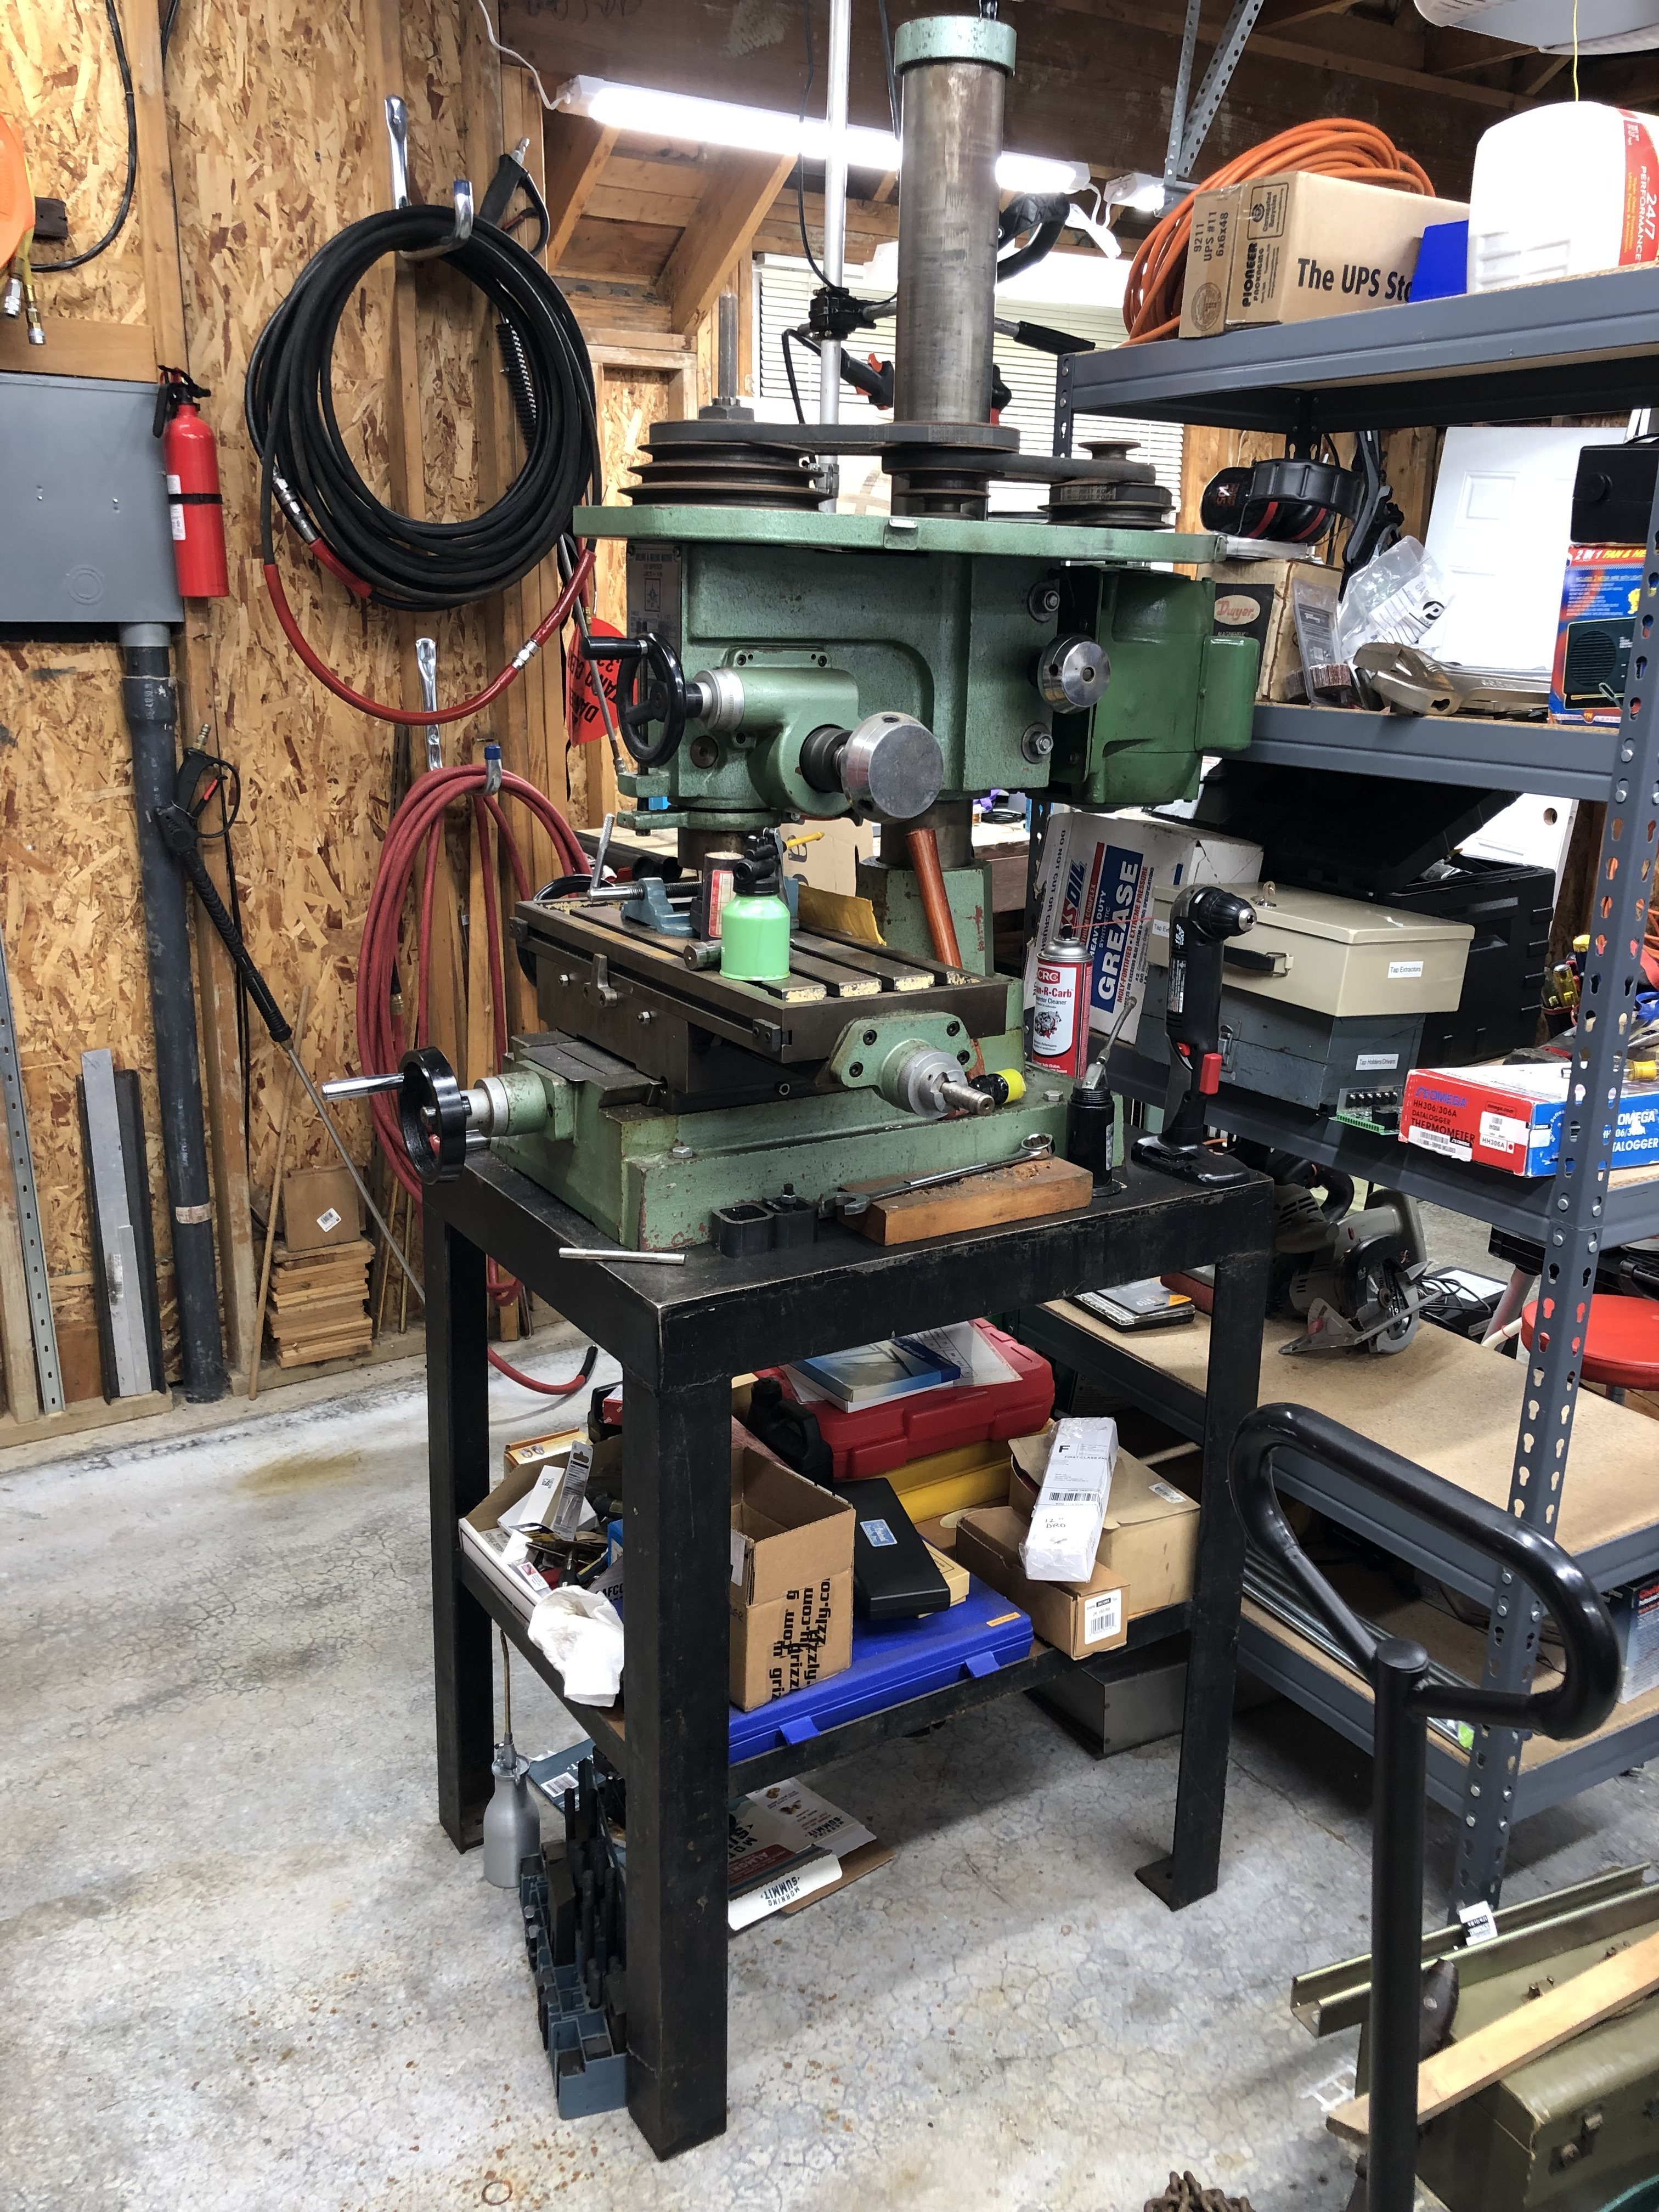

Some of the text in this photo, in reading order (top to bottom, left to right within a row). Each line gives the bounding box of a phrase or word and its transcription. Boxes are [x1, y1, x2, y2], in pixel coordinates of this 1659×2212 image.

[1635, 166, 1647, 261] PERFORMANCE
[1645, 193, 1657, 240] 24/7
[1193, 223, 1204, 253] 9211
[1204, 211, 1217, 262] UPS #11
[1216, 212, 1229, 257] 6x6x48
[1242, 242, 1257, 307] PIONEER
[1253, 248, 1264, 301] PACKAGING
[1298, 258, 1334, 291] The
[1341, 264, 1381, 297] UPS
[1574, 550, 1583, 560] 2
[1583, 549, 1595, 561] IN
[1595, 550, 1603, 559] 1
[1602, 549, 1623, 559] FAN
[1216, 600, 1255, 620] Dwyer
[1059, 830, 1066, 845] DO
[1047, 897, 1054, 912] OR
[1085, 884, 1097, 917] COMPLEX
[1096, 890, 1107, 921] DUTY
[1098, 906, 1110, 949] SYNTHETIC
[1098, 861, 1138, 1000] GREASE
[1117, 946, 1132, 1003] MOLY-FORTIFIED
[1136, 866, 1148, 903] PRESSURE
[1037, 969, 1059, 983] CRC
[1413, 1099, 1457, 1118] HH306/306A
[1432, 1090, 1468, 1108] OMEGA
[1411, 1118, 1475, 1143] THERMOMETER
[1412, 1109, 1451, 1125] DATALOGGER
[1617, 1110, 1655, 1126] OMEGA
[1482, 1136, 1505, 1148] HH306A
[764, 1876, 798, 1900] SUMMIT
[768, 1886, 800, 1906] MORNING
